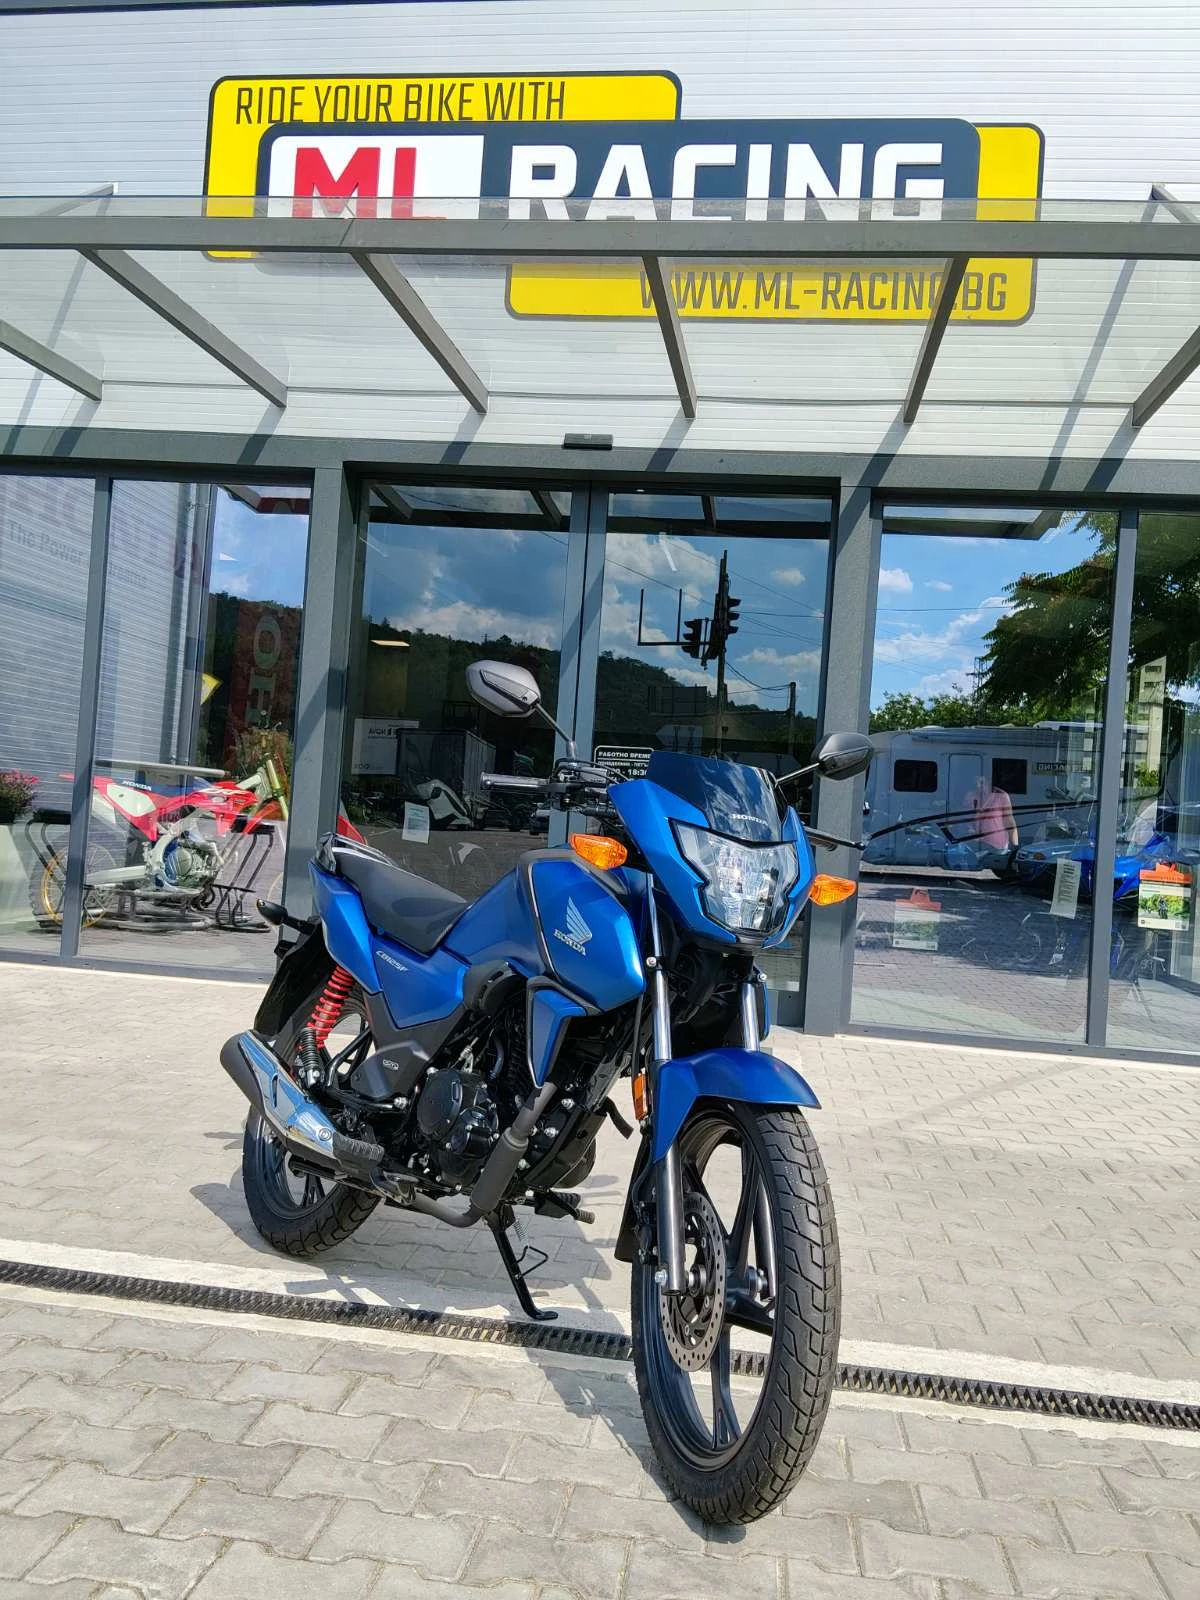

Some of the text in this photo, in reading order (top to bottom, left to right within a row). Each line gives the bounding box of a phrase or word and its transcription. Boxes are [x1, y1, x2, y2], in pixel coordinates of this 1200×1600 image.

[236, 81, 566, 125] RIDE YOUR BIKE WITH
[292, 144, 946, 222] ML RACING
[731, 813, 769, 827] HONDA
[553, 928, 587, 957] HONDA
